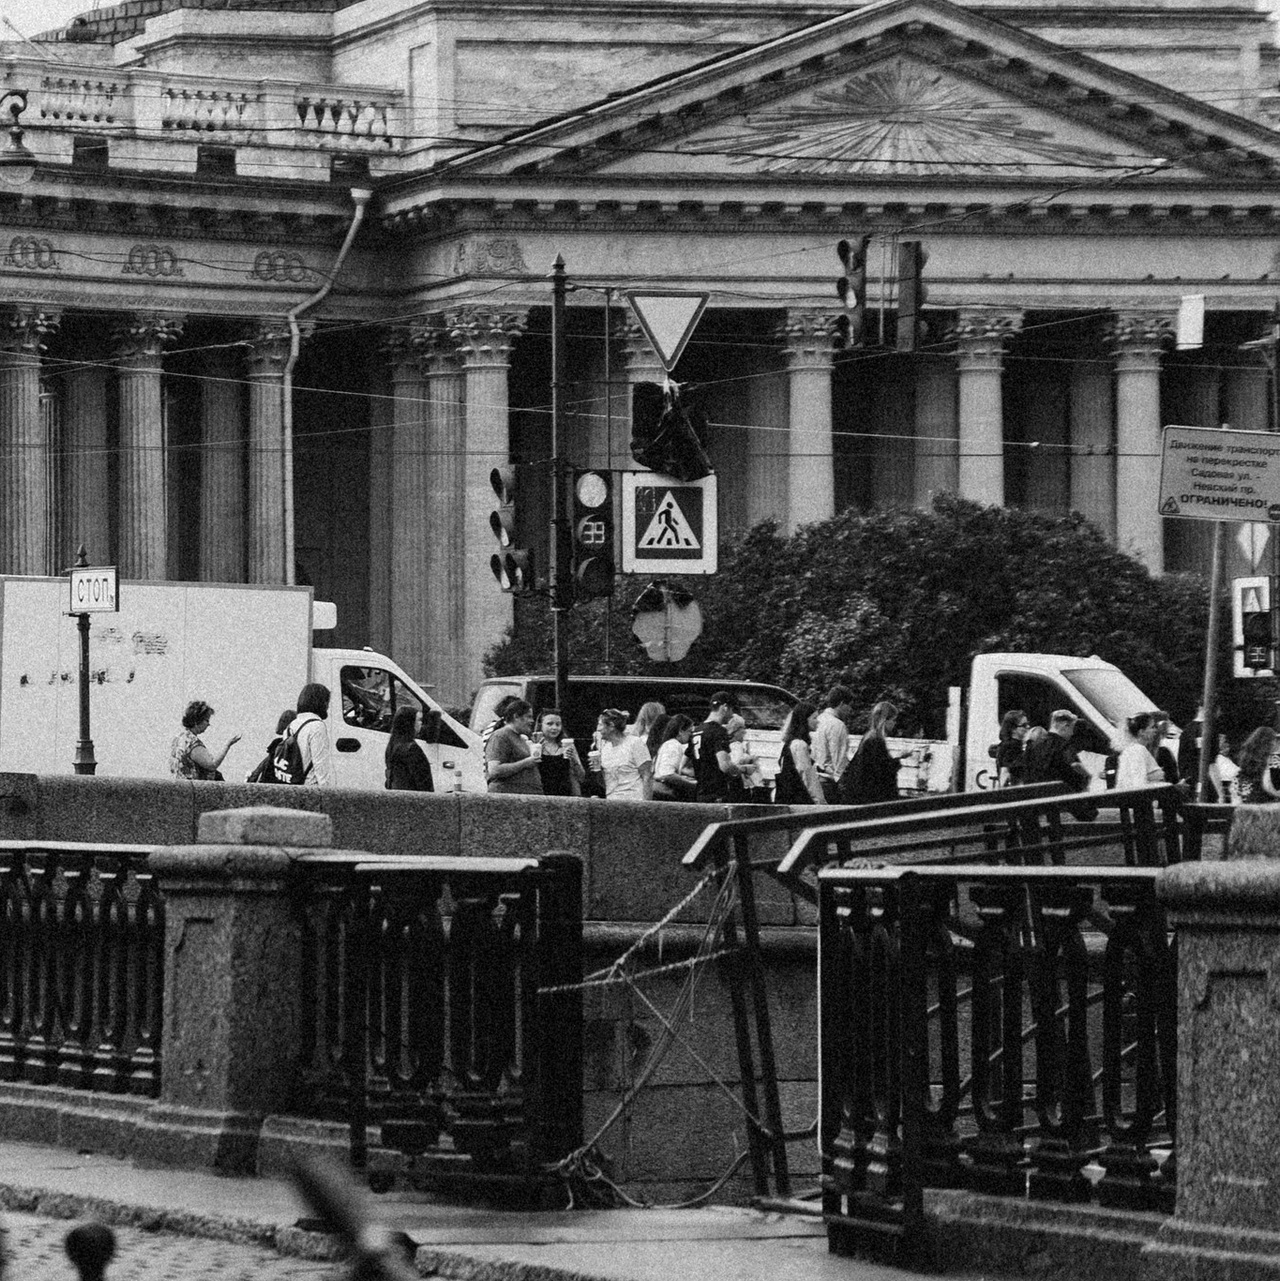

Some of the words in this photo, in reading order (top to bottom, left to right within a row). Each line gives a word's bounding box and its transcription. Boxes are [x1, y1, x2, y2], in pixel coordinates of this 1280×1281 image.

[1170, 439, 1223, 452] Движение
[1186, 456, 1200, 464] на
[1201, 457, 1268, 469] перекрестке
[1191, 468, 1235, 480] Садовая
[1193, 481, 1238, 493] Невский
[1180, 494, 1268, 509] ОГРАНИЧЕНО!
[583, 521, 605, 543] 39
[77, 577, 109, 602] СТОП
